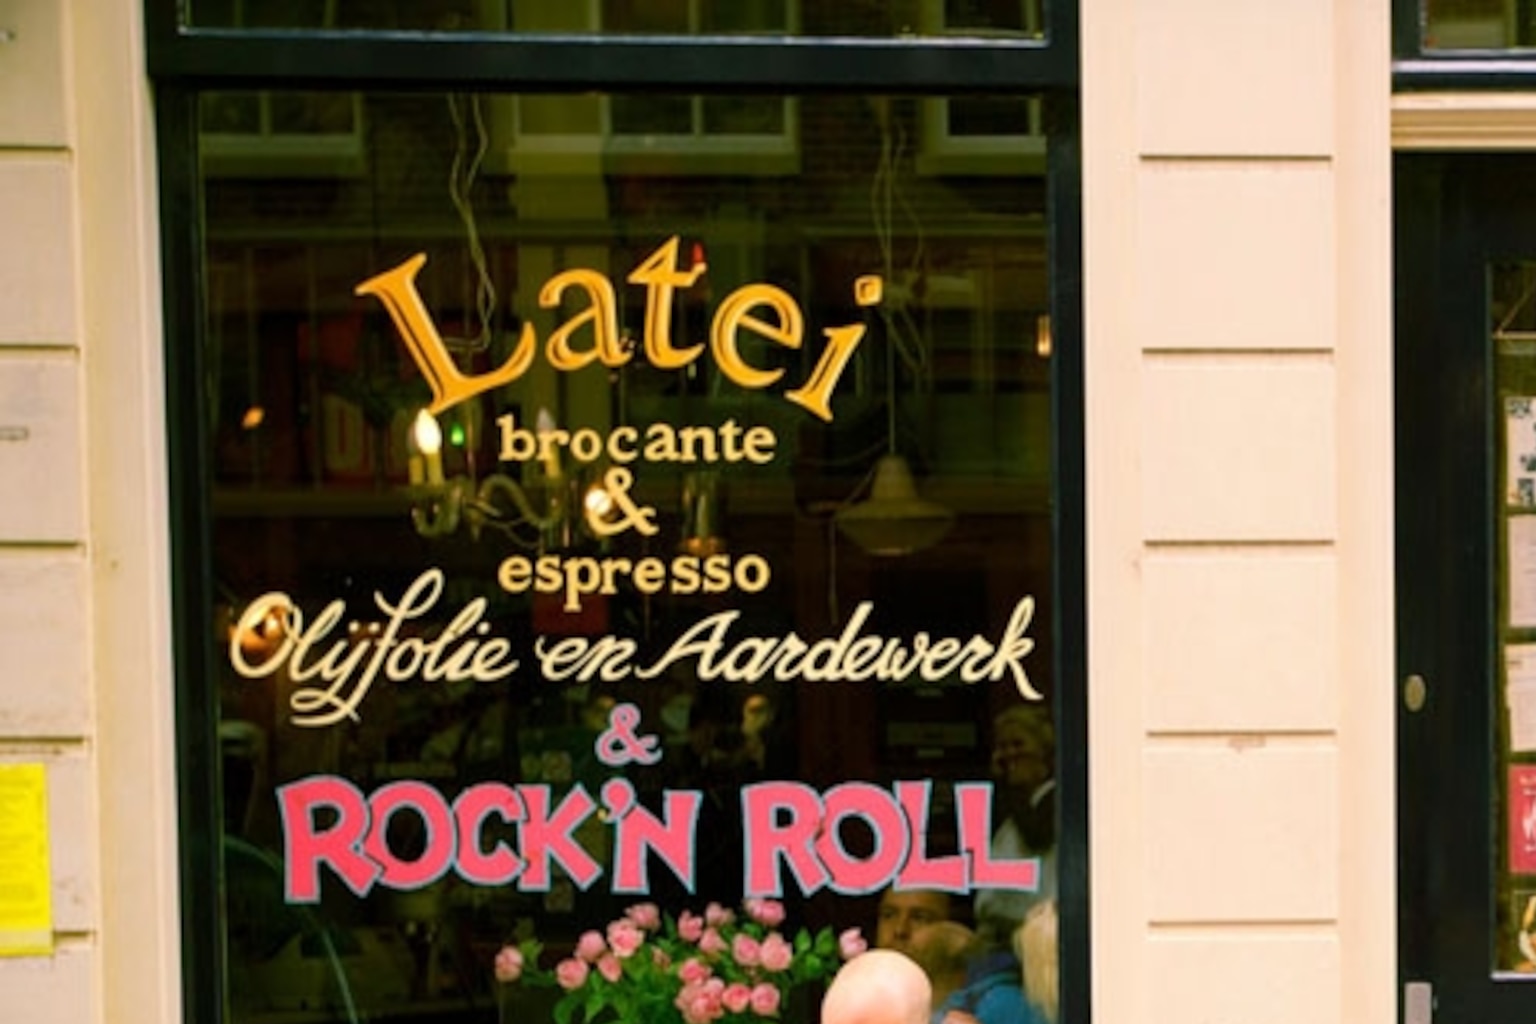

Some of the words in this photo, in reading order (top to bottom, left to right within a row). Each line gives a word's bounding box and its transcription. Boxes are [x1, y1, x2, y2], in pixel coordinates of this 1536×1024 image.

[355, 234, 883, 421] Latei
[498, 416, 776, 464] brocante
[587, 467, 659, 536] &
[498, 552, 770, 611] espresso
[534, 634, 632, 684] en
[635, 597, 1044, 701] Aardewerk
[595, 703, 662, 765] &
[276, 775, 702, 903] ROCK'N
[742, 779, 1041, 896] ROLL
